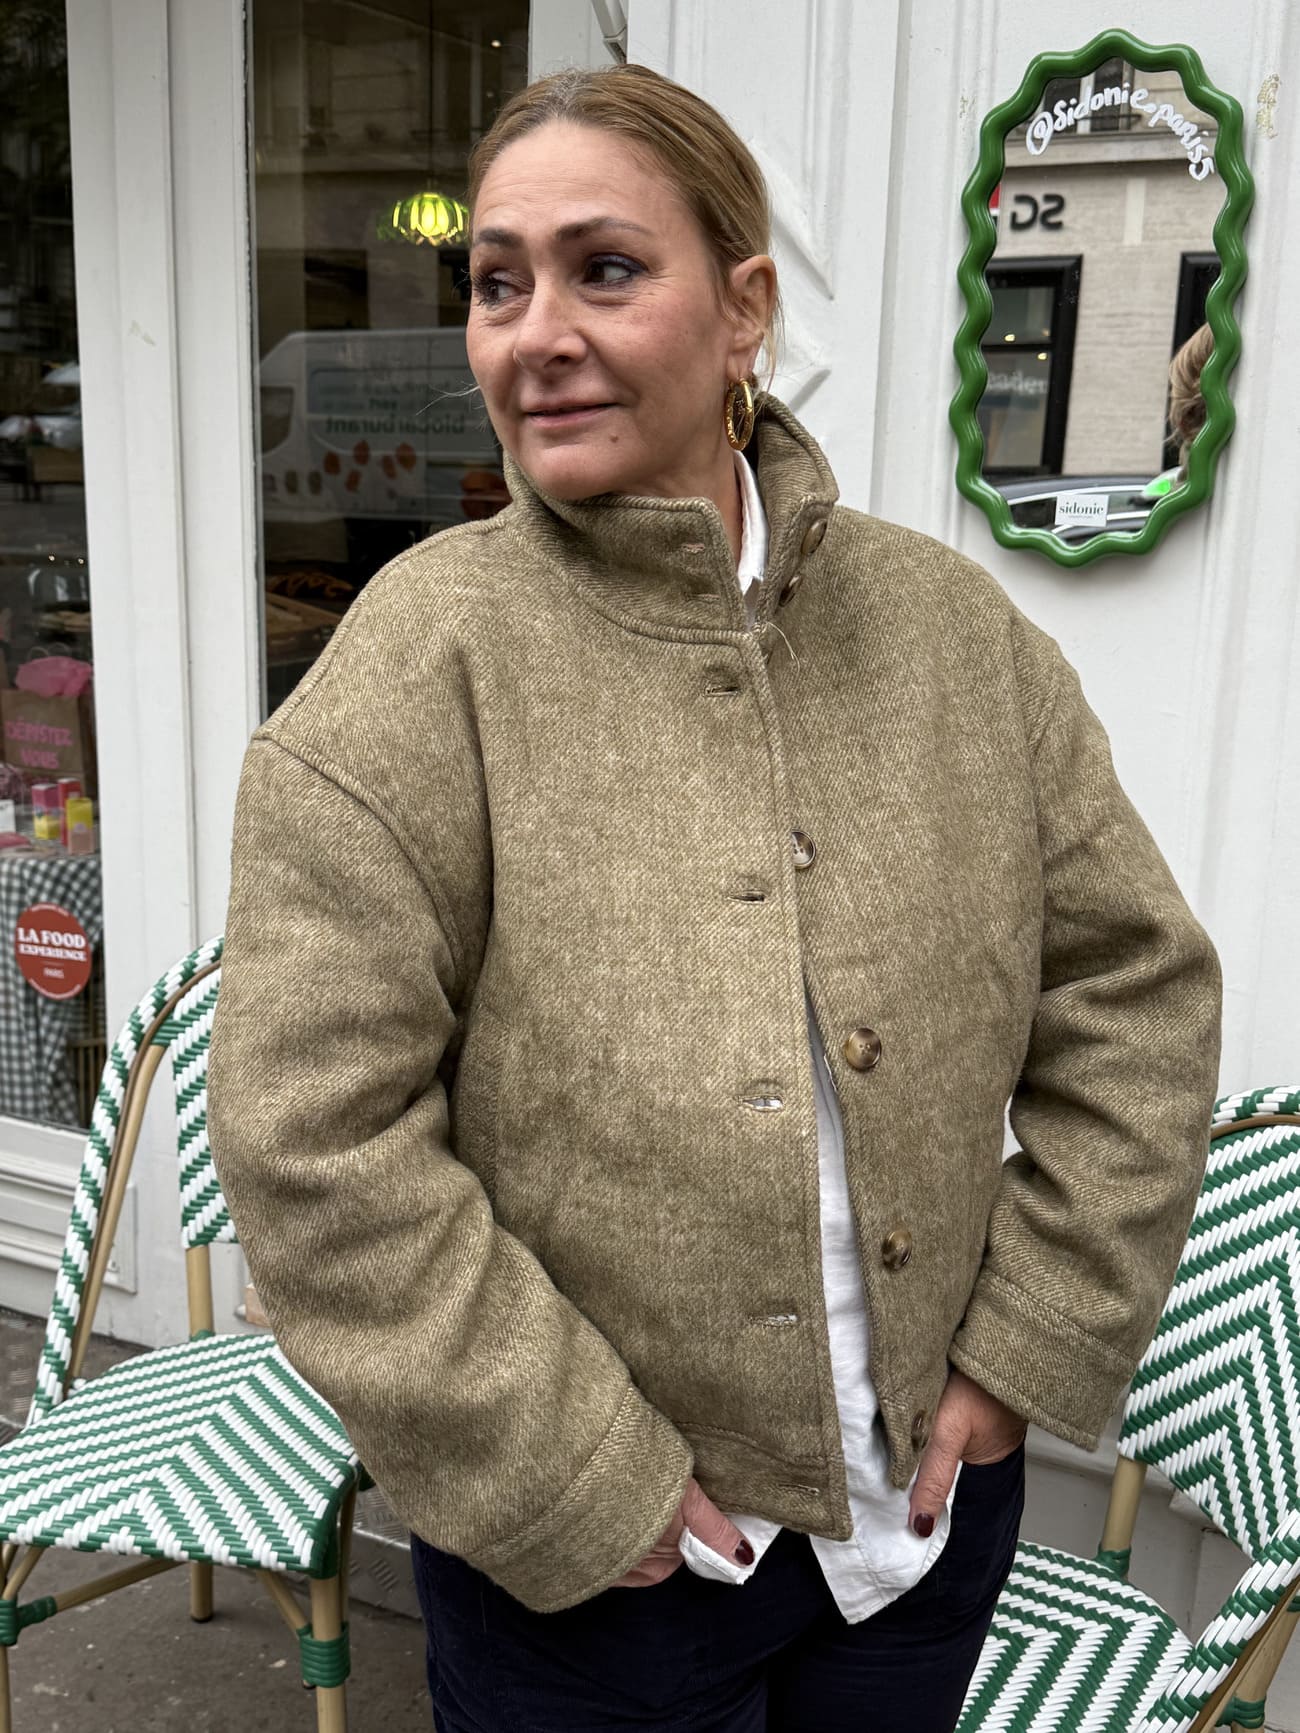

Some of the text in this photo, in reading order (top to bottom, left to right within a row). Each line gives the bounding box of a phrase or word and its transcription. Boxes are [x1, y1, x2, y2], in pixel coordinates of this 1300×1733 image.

[1058, 502, 1104, 515] sidonie
[17, 927, 86, 949] LA FOOD
[18, 944, 87, 963] EXPERIENCE
